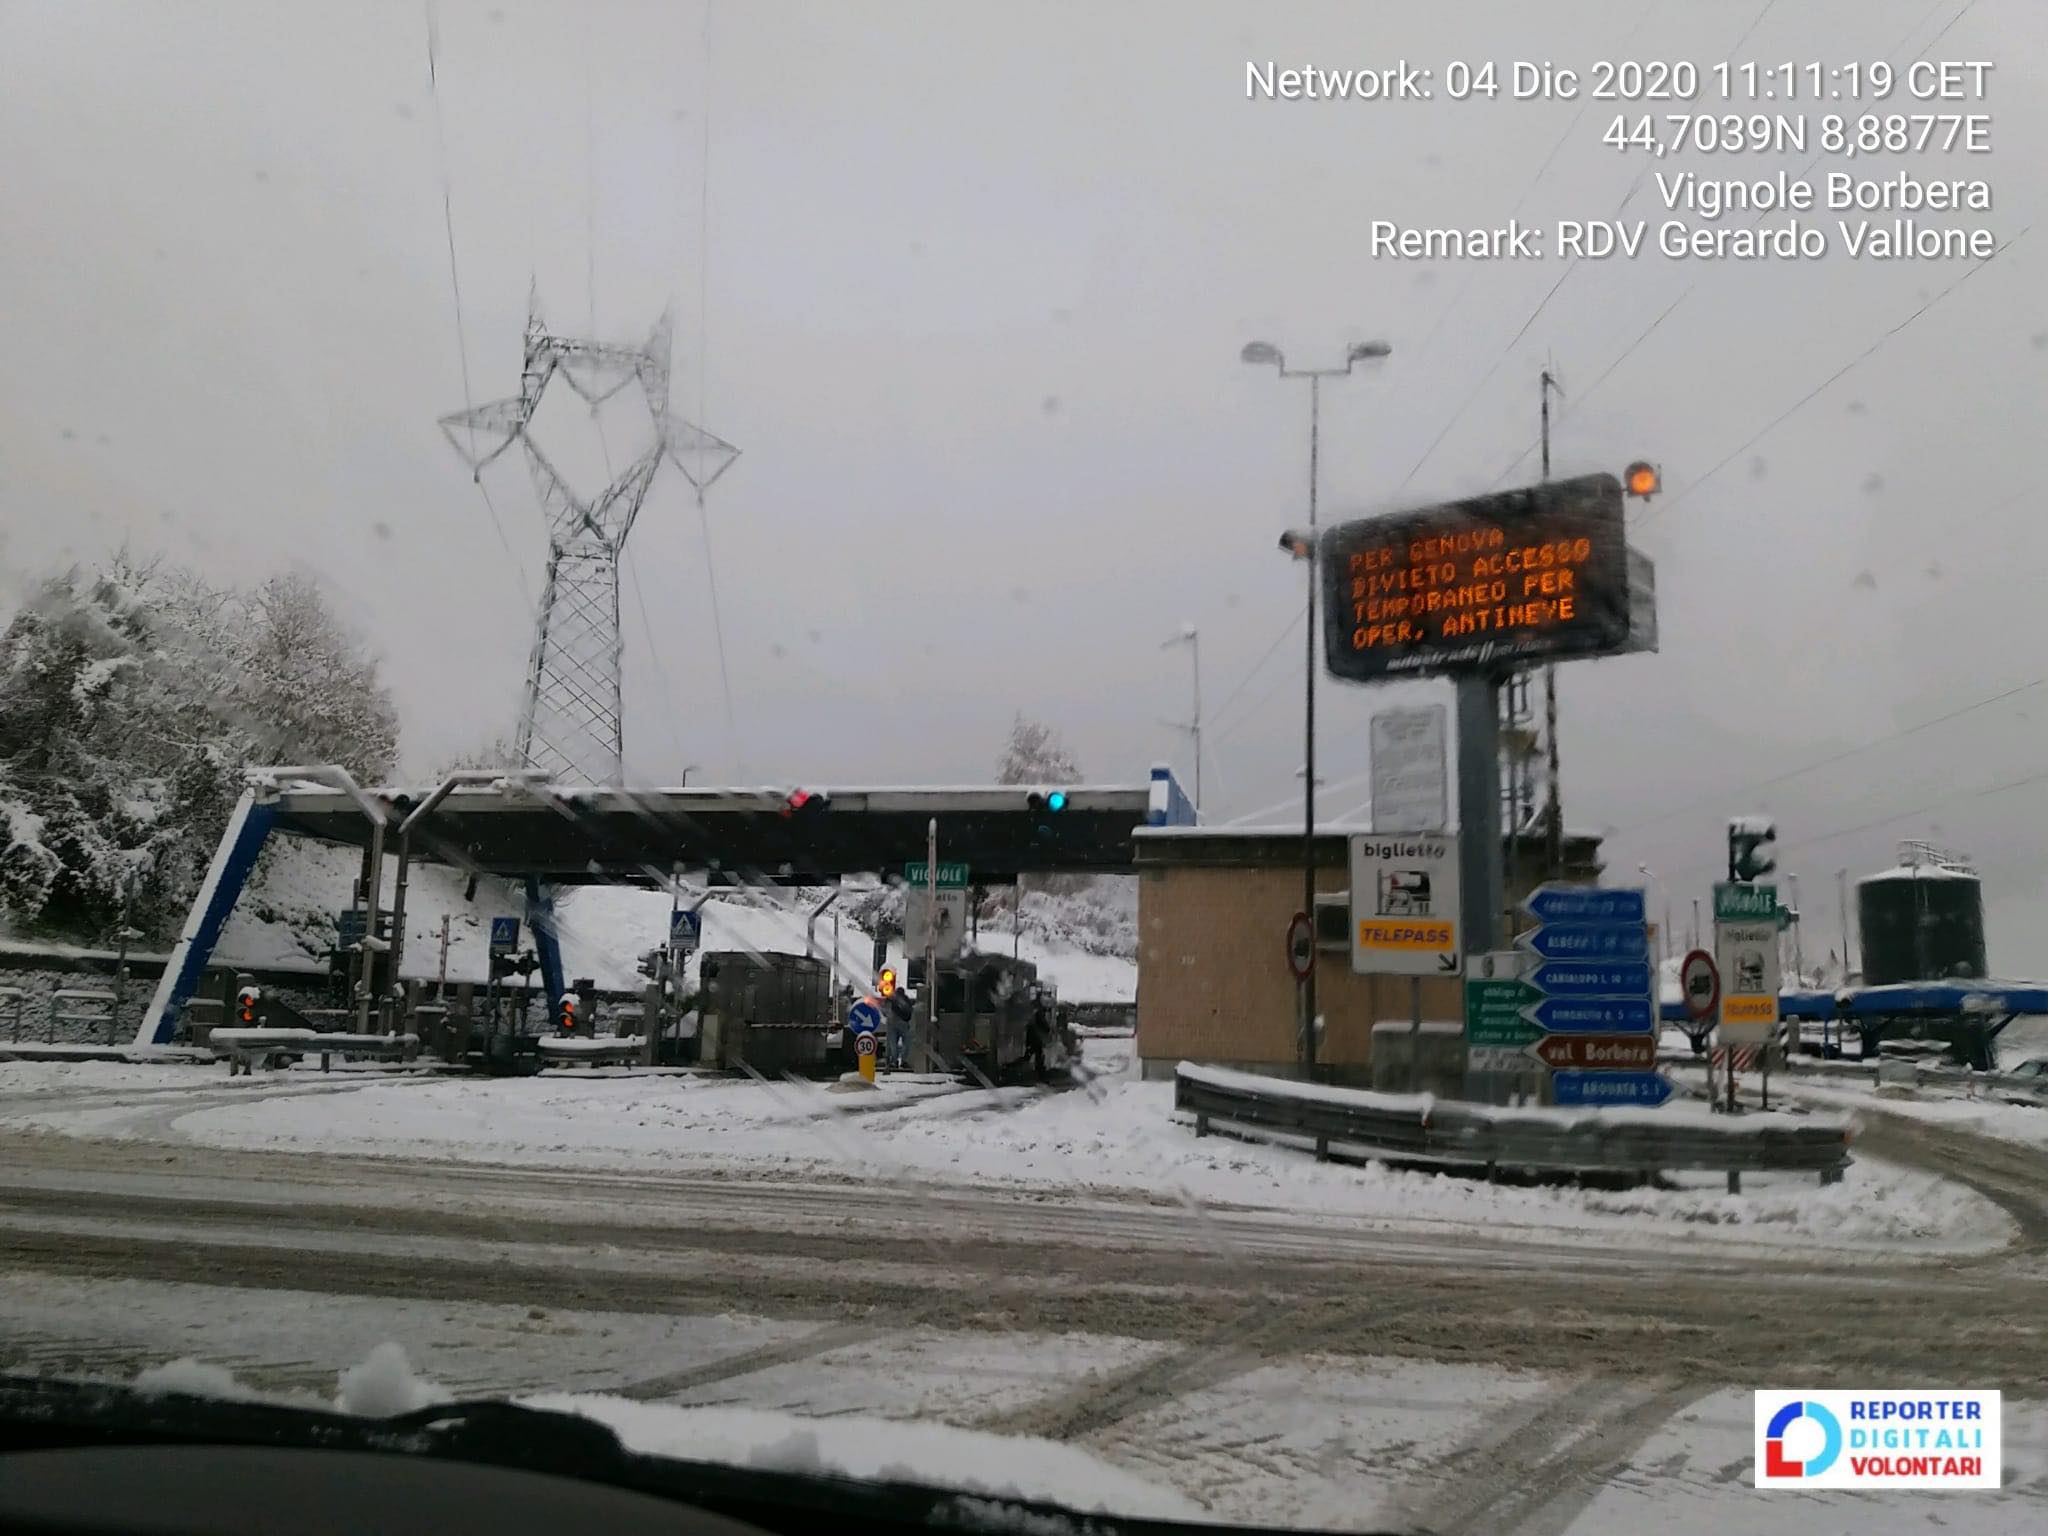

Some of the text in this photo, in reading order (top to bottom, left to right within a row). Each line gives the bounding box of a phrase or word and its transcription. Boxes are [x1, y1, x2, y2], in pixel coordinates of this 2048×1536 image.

[1350, 528, 1505, 572] PER GENOVA
[1351, 537, 1591, 598] DIVIETO ACCESSO
[1353, 567, 1575, 623] TEMPORANEO PER
[1364, 842, 1446, 860] biglietto
[1364, 927, 1450, 944] TELEPASS
[859, 1040, 872, 1052] 30
[1586, 1042, 1649, 1062] Borbera
